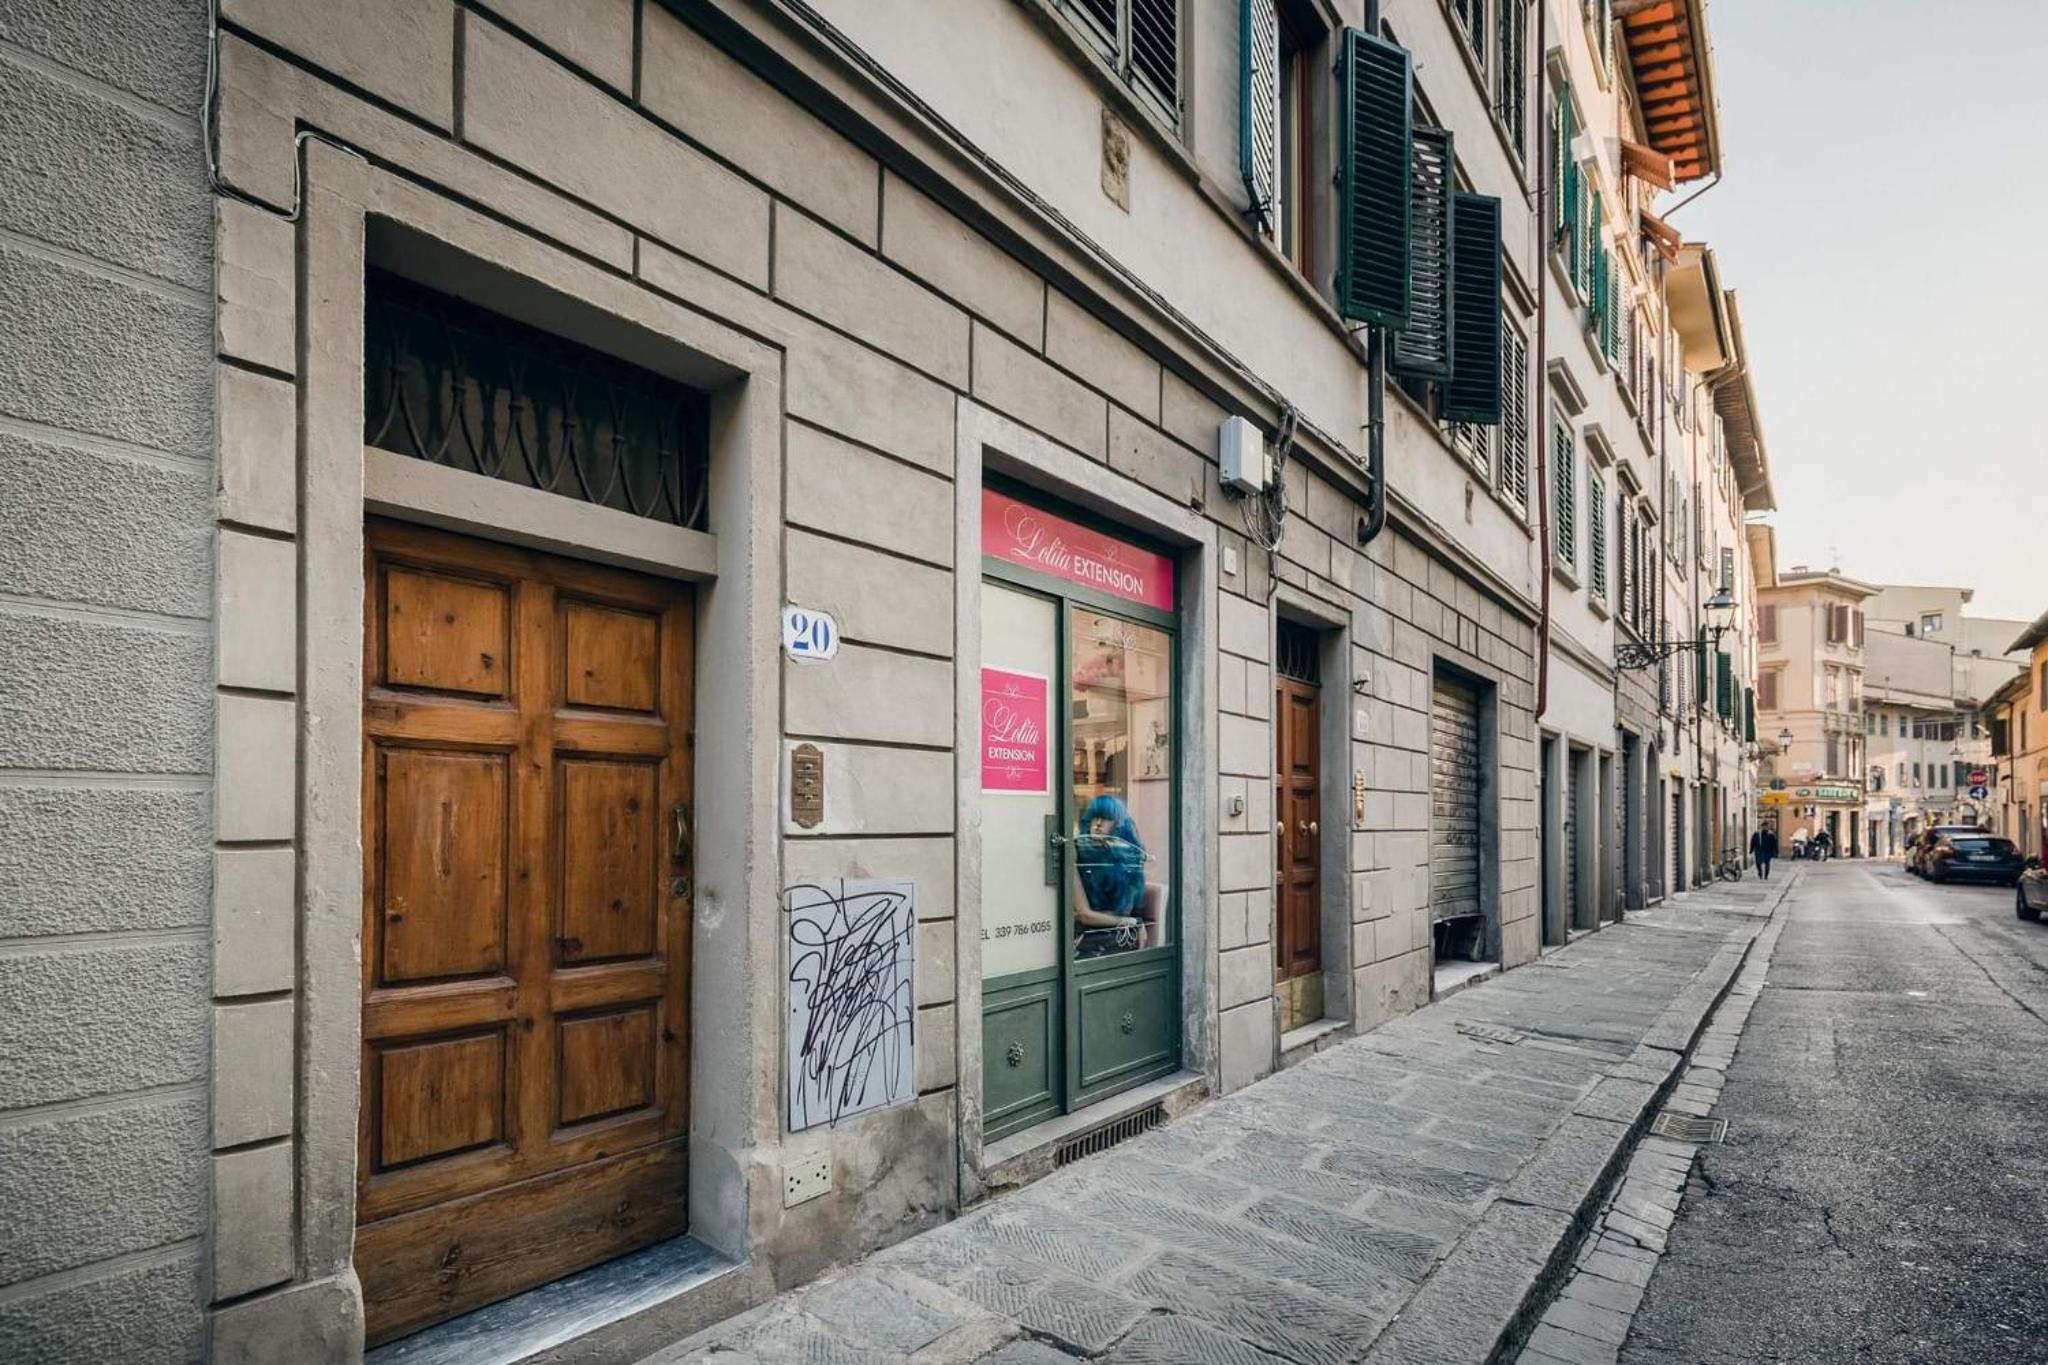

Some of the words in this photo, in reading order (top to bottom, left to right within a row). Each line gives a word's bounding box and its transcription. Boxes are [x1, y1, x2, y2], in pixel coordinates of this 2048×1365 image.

[1004, 505, 1072, 571] Lolita
[1074, 556, 1144, 595] EXTENSION
[791, 613, 830, 652] 20
[982, 698, 1039, 745] Lolita
[988, 747, 1035, 761] EXTENSION
[995, 926, 1012, 939] 339
